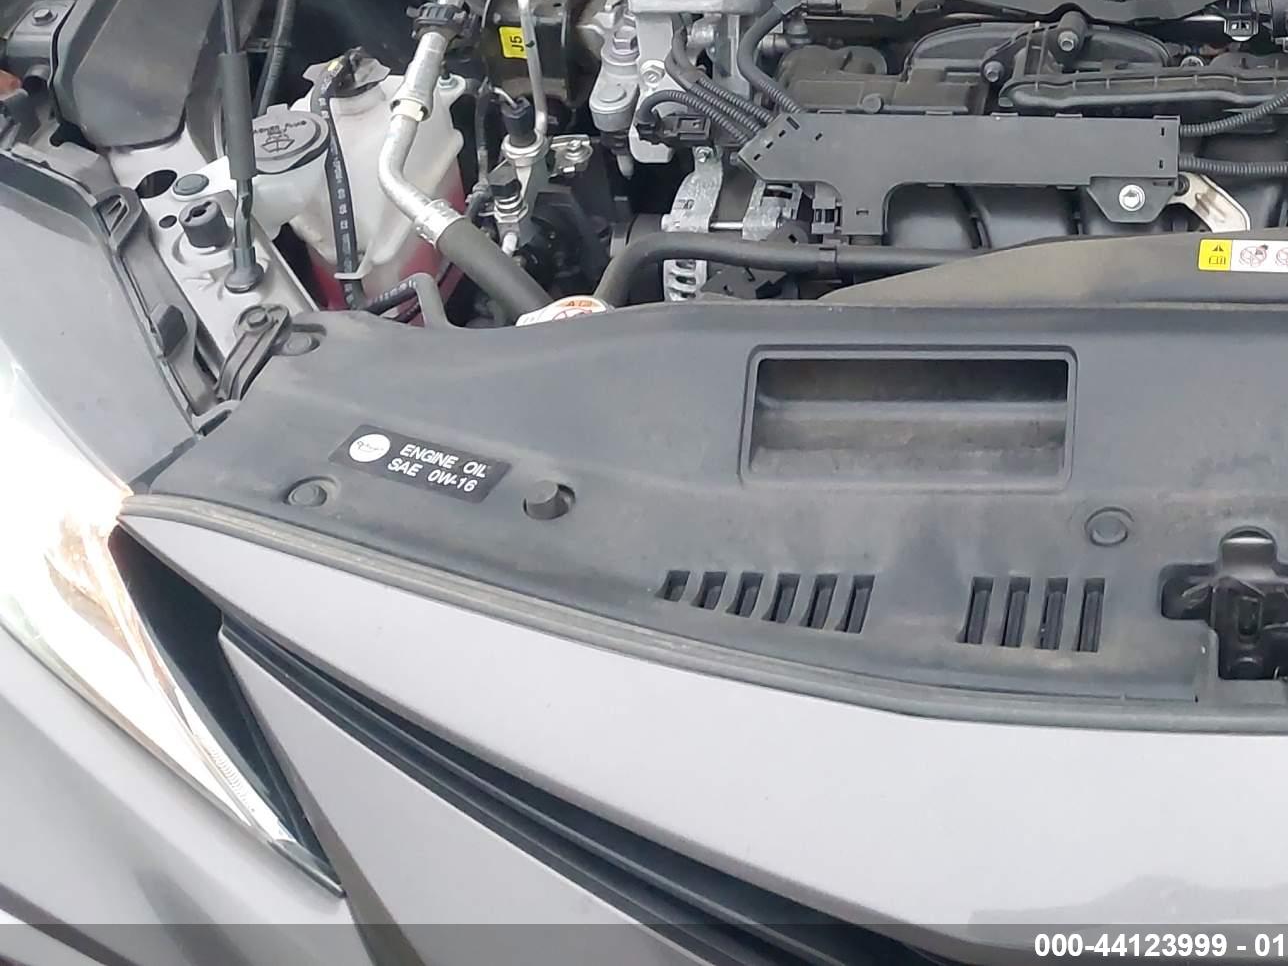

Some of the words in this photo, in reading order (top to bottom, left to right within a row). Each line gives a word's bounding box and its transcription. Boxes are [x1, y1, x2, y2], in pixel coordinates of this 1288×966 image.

[387, 458, 423, 477] SAE
[427, 469, 478, 492] 0W-16
[400, 444, 459, 469] ENGINE
[463, 461, 487, 478] OIL
